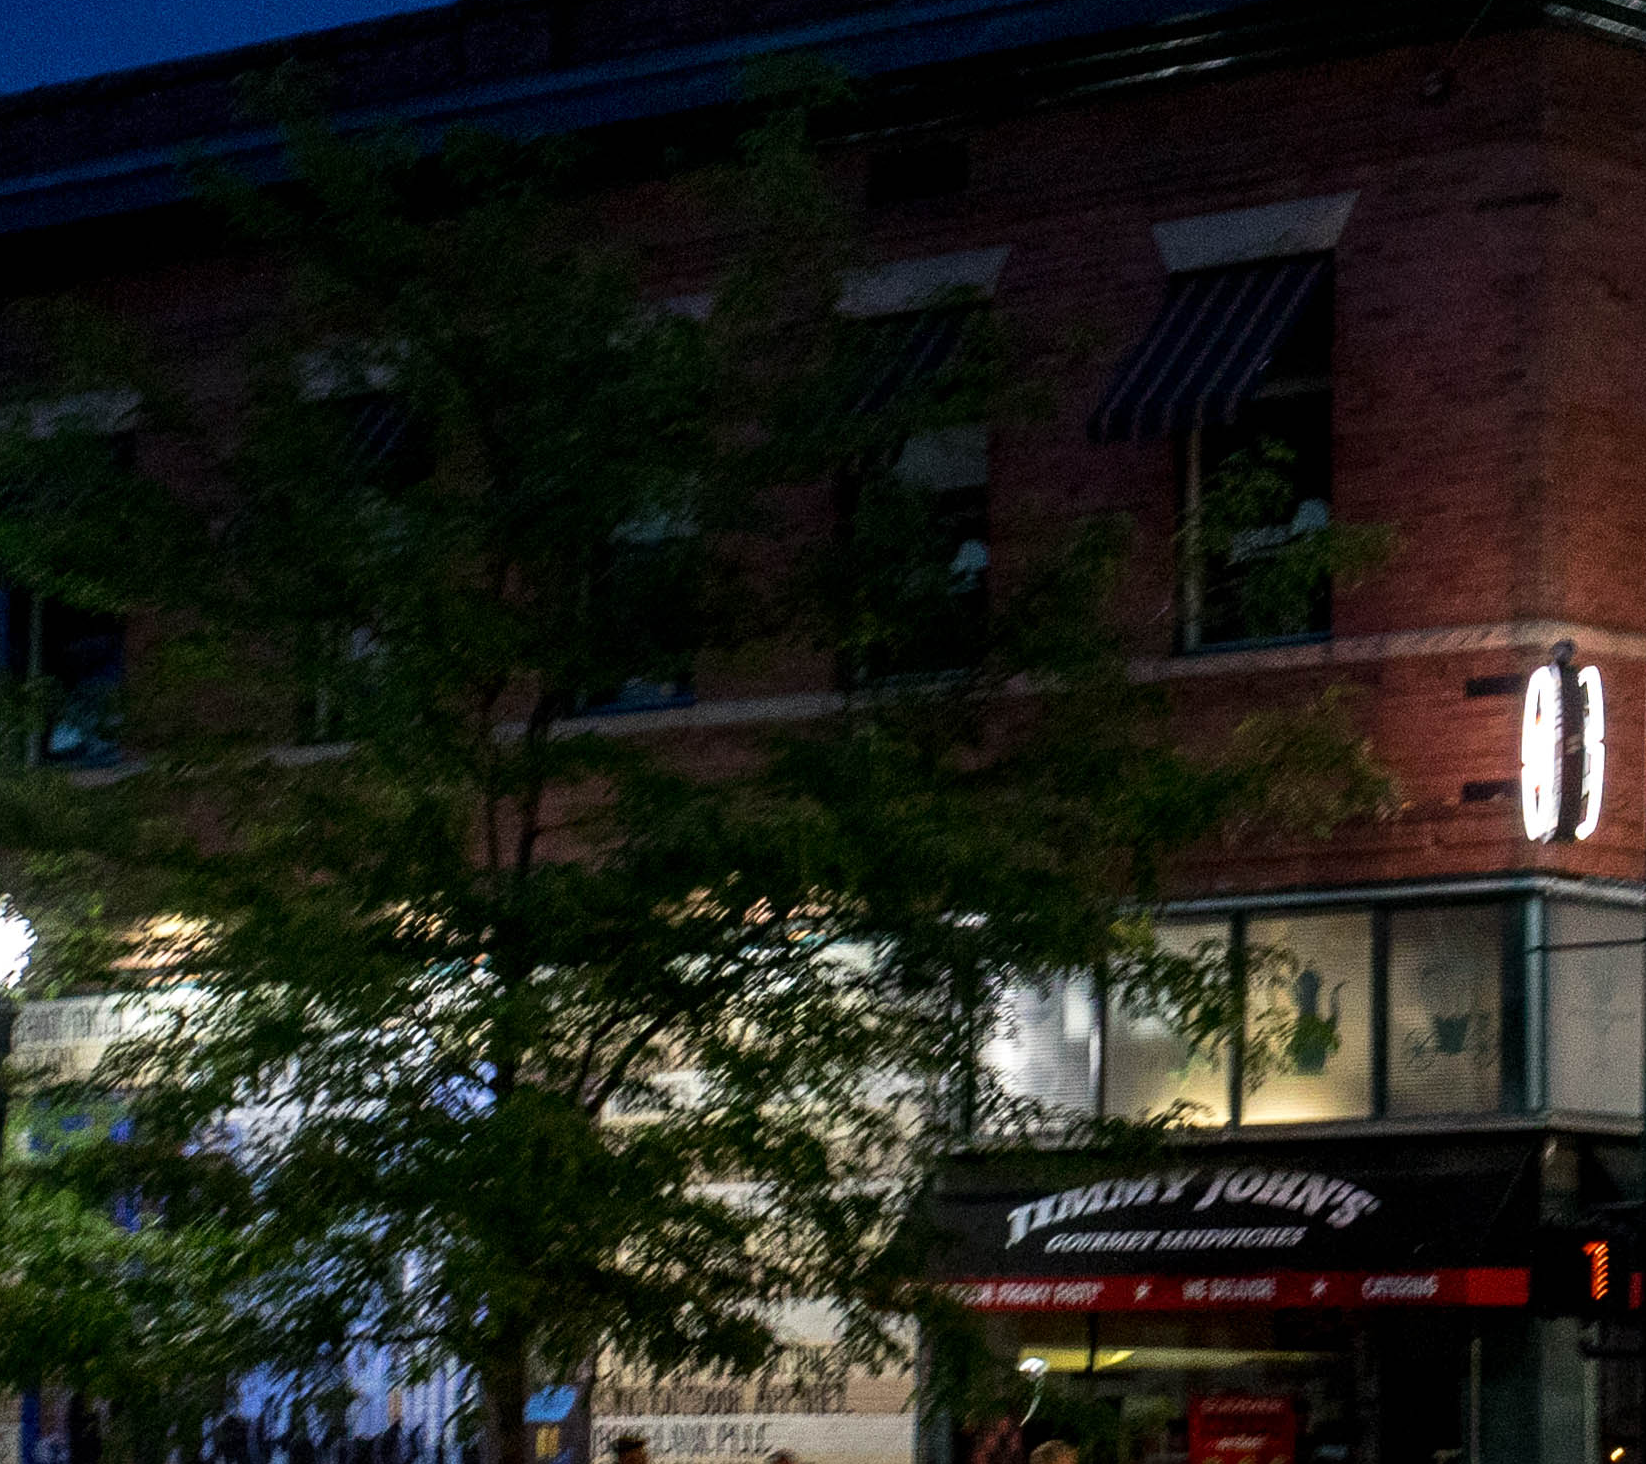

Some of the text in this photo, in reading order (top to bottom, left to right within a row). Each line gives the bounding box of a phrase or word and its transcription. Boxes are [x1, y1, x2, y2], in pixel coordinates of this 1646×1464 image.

[1004, 1166, 1206, 1250] JIMMY
[1043, 1224, 1310, 1255] GOURMET SANDWICHES
